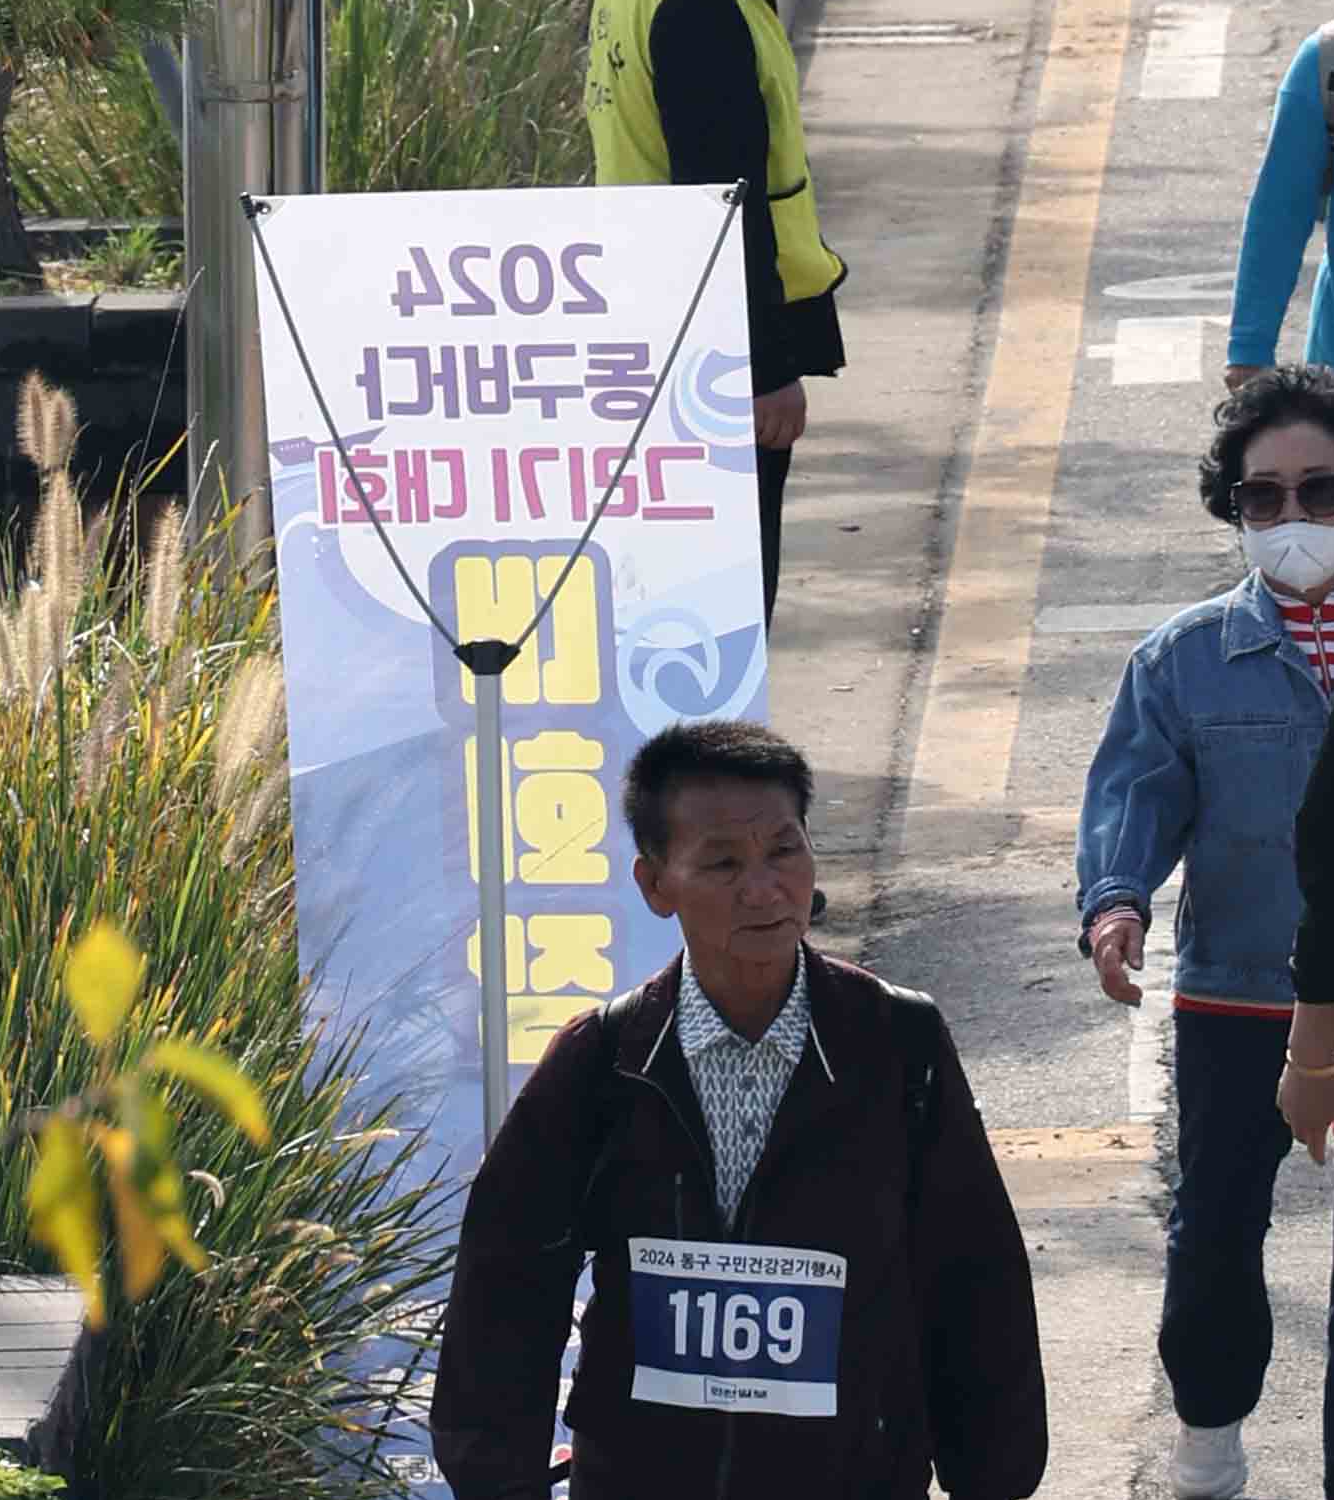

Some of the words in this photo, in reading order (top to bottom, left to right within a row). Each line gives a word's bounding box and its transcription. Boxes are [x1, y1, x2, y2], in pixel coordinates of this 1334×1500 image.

[639, 1249, 675, 1267] 2024
[680, 1252, 712, 1271] 동구
[716, 1254, 843, 1280] 구민건강걷기행사
[668, 1289, 805, 1365] 1169
